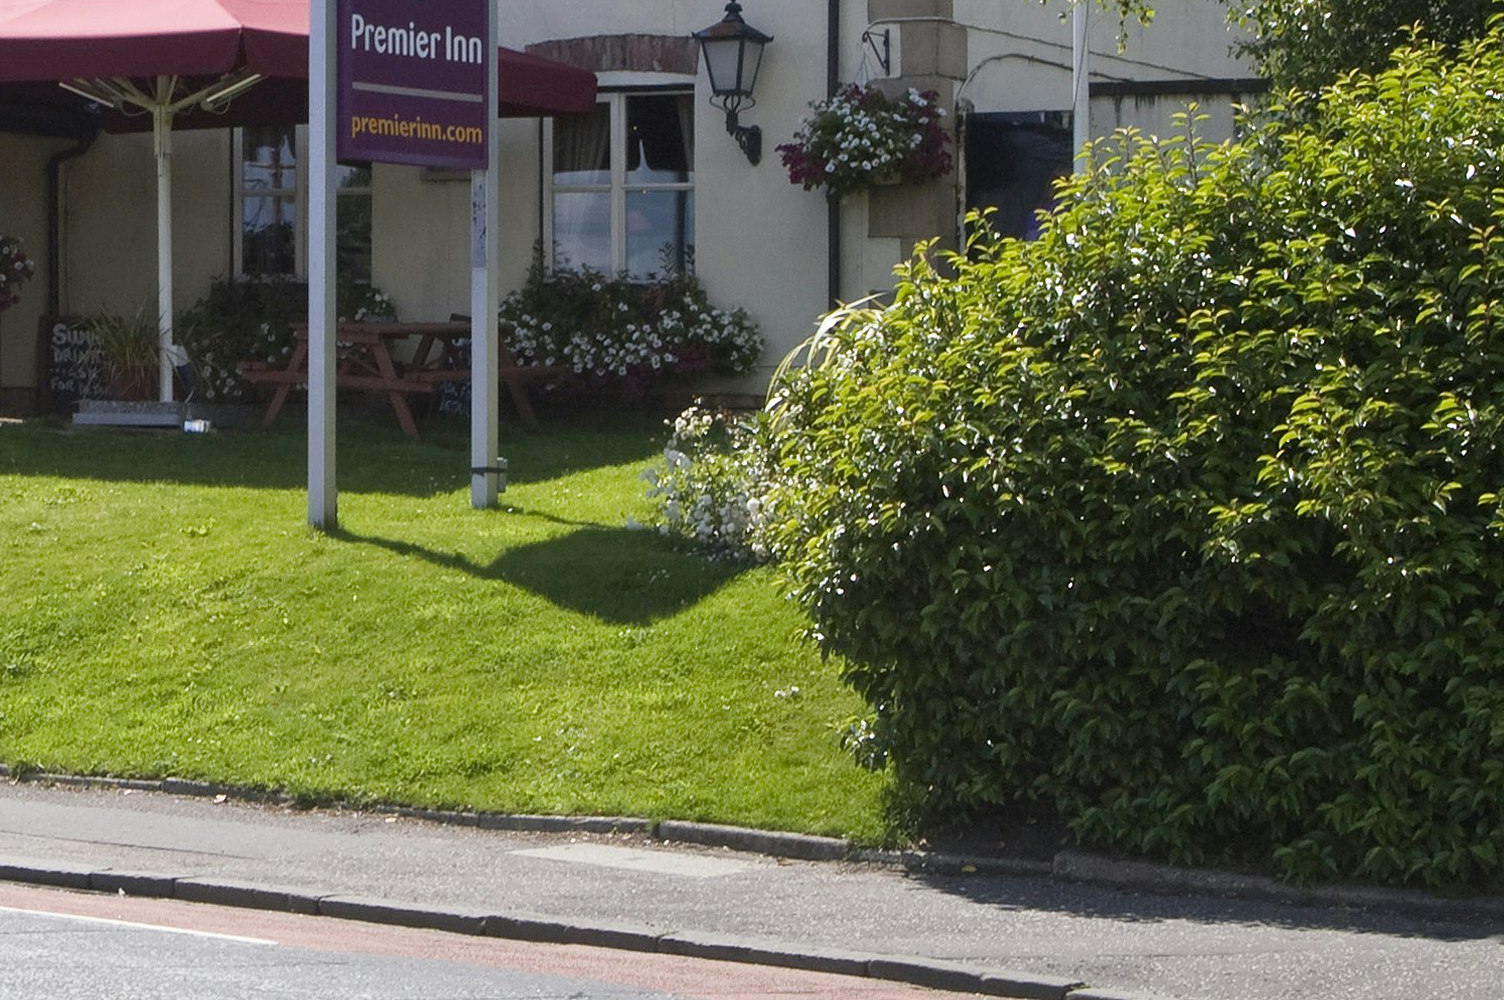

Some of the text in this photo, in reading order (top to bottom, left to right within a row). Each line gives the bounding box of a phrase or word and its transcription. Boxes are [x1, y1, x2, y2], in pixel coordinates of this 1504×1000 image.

[351, 13, 482, 65] Premier Inn
[351, 113, 483, 144] premierinn.com
